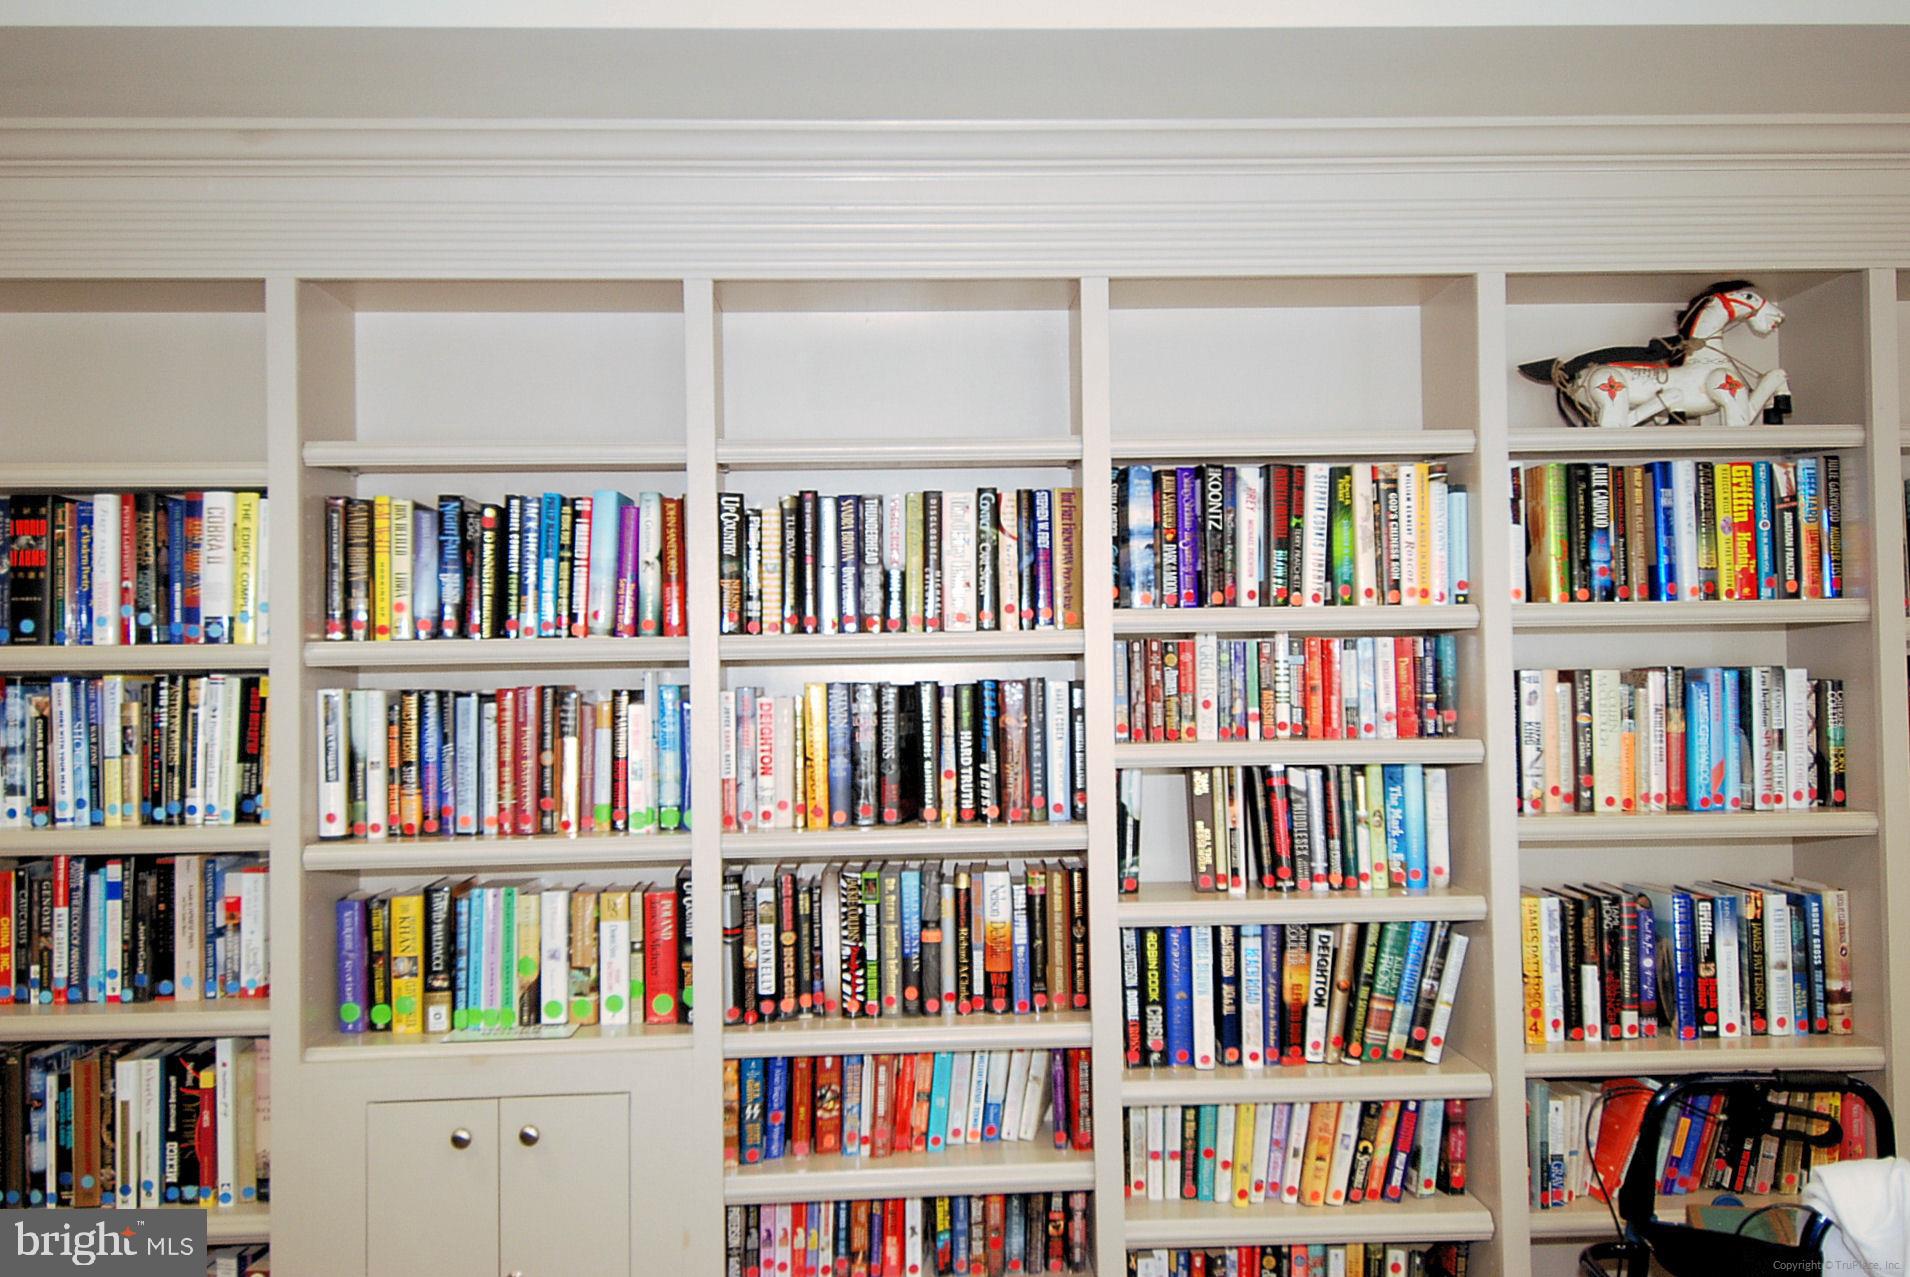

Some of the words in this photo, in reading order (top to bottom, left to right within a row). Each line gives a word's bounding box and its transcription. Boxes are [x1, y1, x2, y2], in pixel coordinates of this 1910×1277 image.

[1592, 466, 1610, 487] JULIE
[1731, 465, 1753, 523] Griffin
[1208, 473, 1223, 530] KOONTZ
[1592, 489, 1610, 529] GARWOOD
[864, 499, 879, 565] THUNDERHEAD
[1783, 512, 1792, 546] JONATHAN
[1785, 548, 1795, 580] FRANZEN
[882, 688, 897, 712] JACK
[760, 703, 773, 776] DEIGHTON
[882, 714, 897, 759] HIGGINS
[960, 730, 973, 766] HARD
[960, 767, 973, 809] TRUTH
[1389, 786, 1402, 807] The
[1293, 802, 1308, 857] MIDDLESEX
[18, 889, 29, 944] CAUCASUS
[41, 881, 51, 933] GENOME
[431, 893, 447, 923] DAVID
[661, 900, 673, 941] POLAND
[990, 885, 1006, 917] Nelson
[1811, 902, 1820, 936] ANDREW
[0, 917, 11, 949] CHINA
[398, 916, 412, 953] KHAN
[988, 921, 1005, 959] DeMille
[1698, 901, 1712, 943] Griffin
[1751, 922, 1763, 951] JAMES
[431, 924, 445, 971] BALDACCI
[760, 932, 771, 992] CONNELLY
[1146, 931, 1160, 969] ROBIN
[1811, 938, 1820, 966] GROSS
[1148, 970, 1160, 1001] COOK
[1313, 934, 1331, 1008] DEIGHTON
[1529, 945, 1543, 1017] PATTERSO
[1753, 954, 1765, 1010] PATTERSON
[1146, 1005, 1164, 1050] CRISI
[1550, 1161, 1564, 1206] GRAVY
